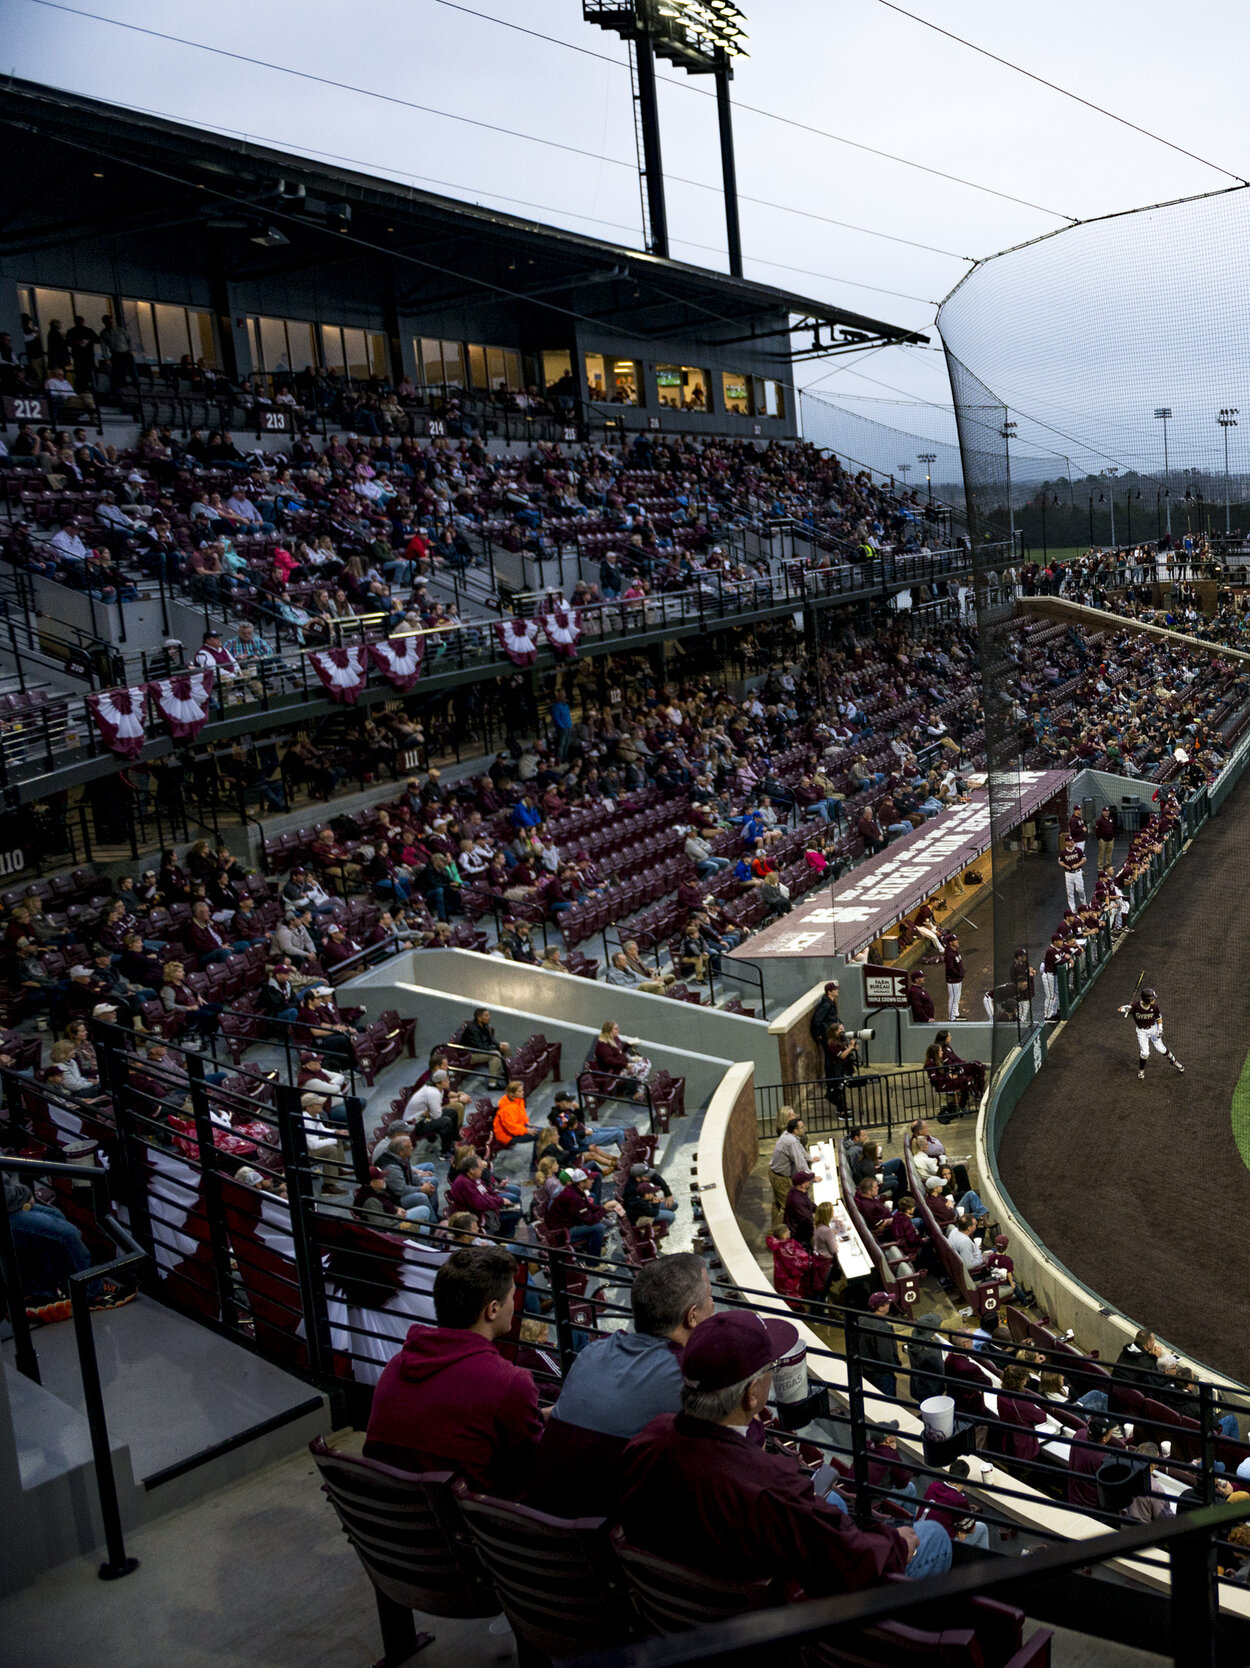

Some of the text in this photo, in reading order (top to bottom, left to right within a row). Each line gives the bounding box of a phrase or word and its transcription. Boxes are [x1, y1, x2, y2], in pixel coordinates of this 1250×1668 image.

[13, 398, 43, 419] 212
[266, 412, 285, 429] 213
[429, 421, 444, 436] 214
[610, 688, 621, 703] 112
[404, 750, 420, 769] 111
[911, 833, 975, 863] WORLD
[859, 865, 932, 901] SERIES
